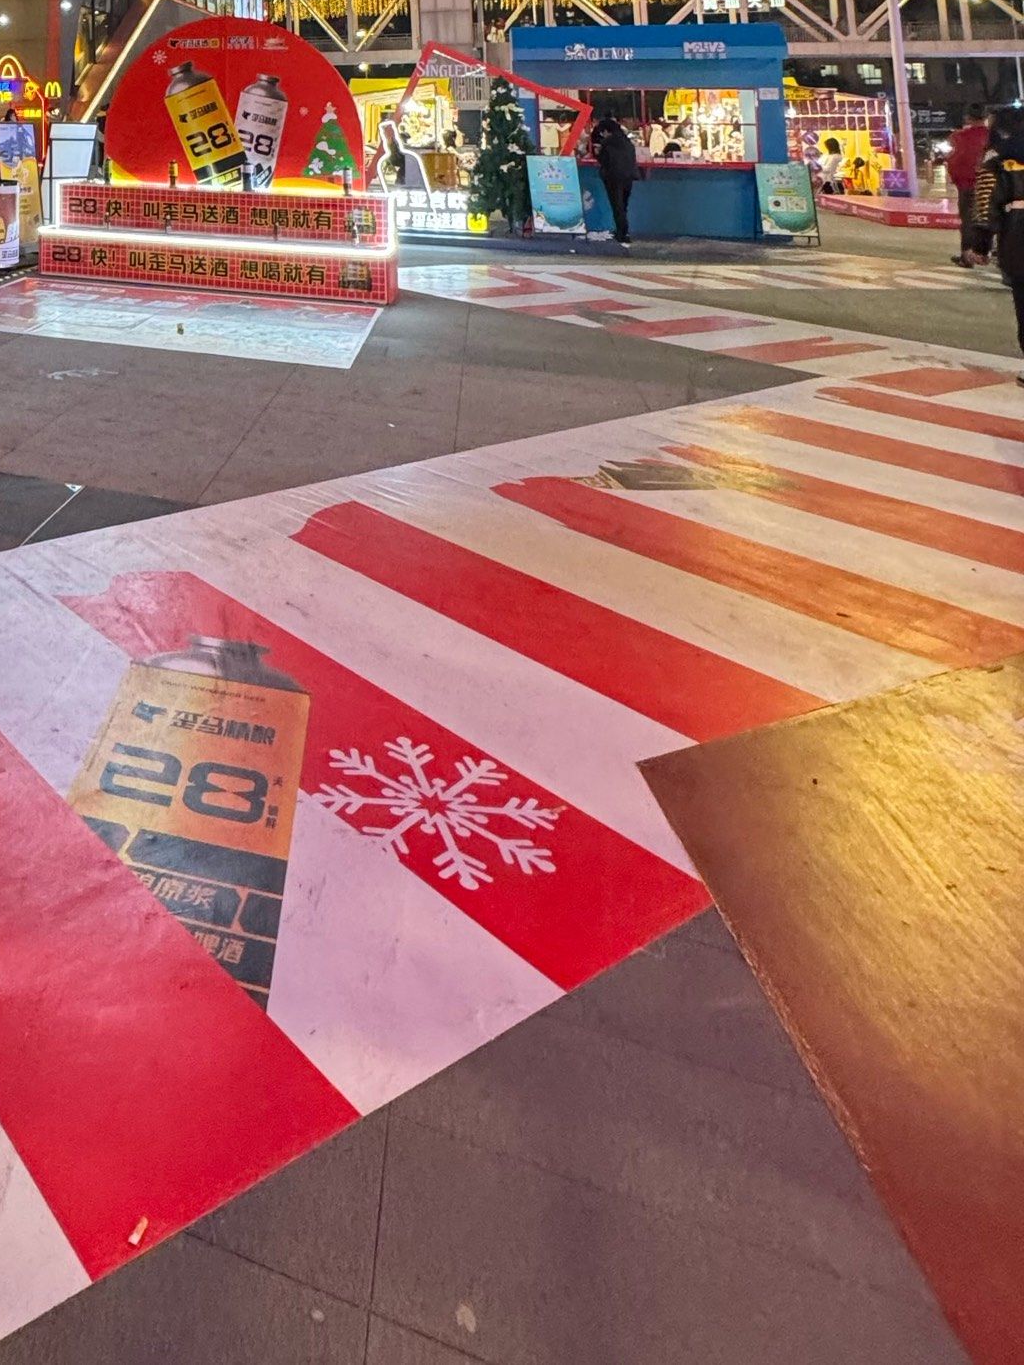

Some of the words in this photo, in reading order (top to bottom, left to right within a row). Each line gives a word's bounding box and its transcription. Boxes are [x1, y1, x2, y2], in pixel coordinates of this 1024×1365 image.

[186, 122, 232, 158] 28
[238, 129, 274, 156] 28
[68, 197, 98, 214] 28
[143, 202, 239, 225] 叫歪马送酒
[250, 207, 332, 230] 想喝就有
[52, 246, 82, 263] 28
[129, 250, 229, 276] 叫歪马送酒
[240, 255, 325, 285] 想喝就有
[99, 742, 269, 824] 28
